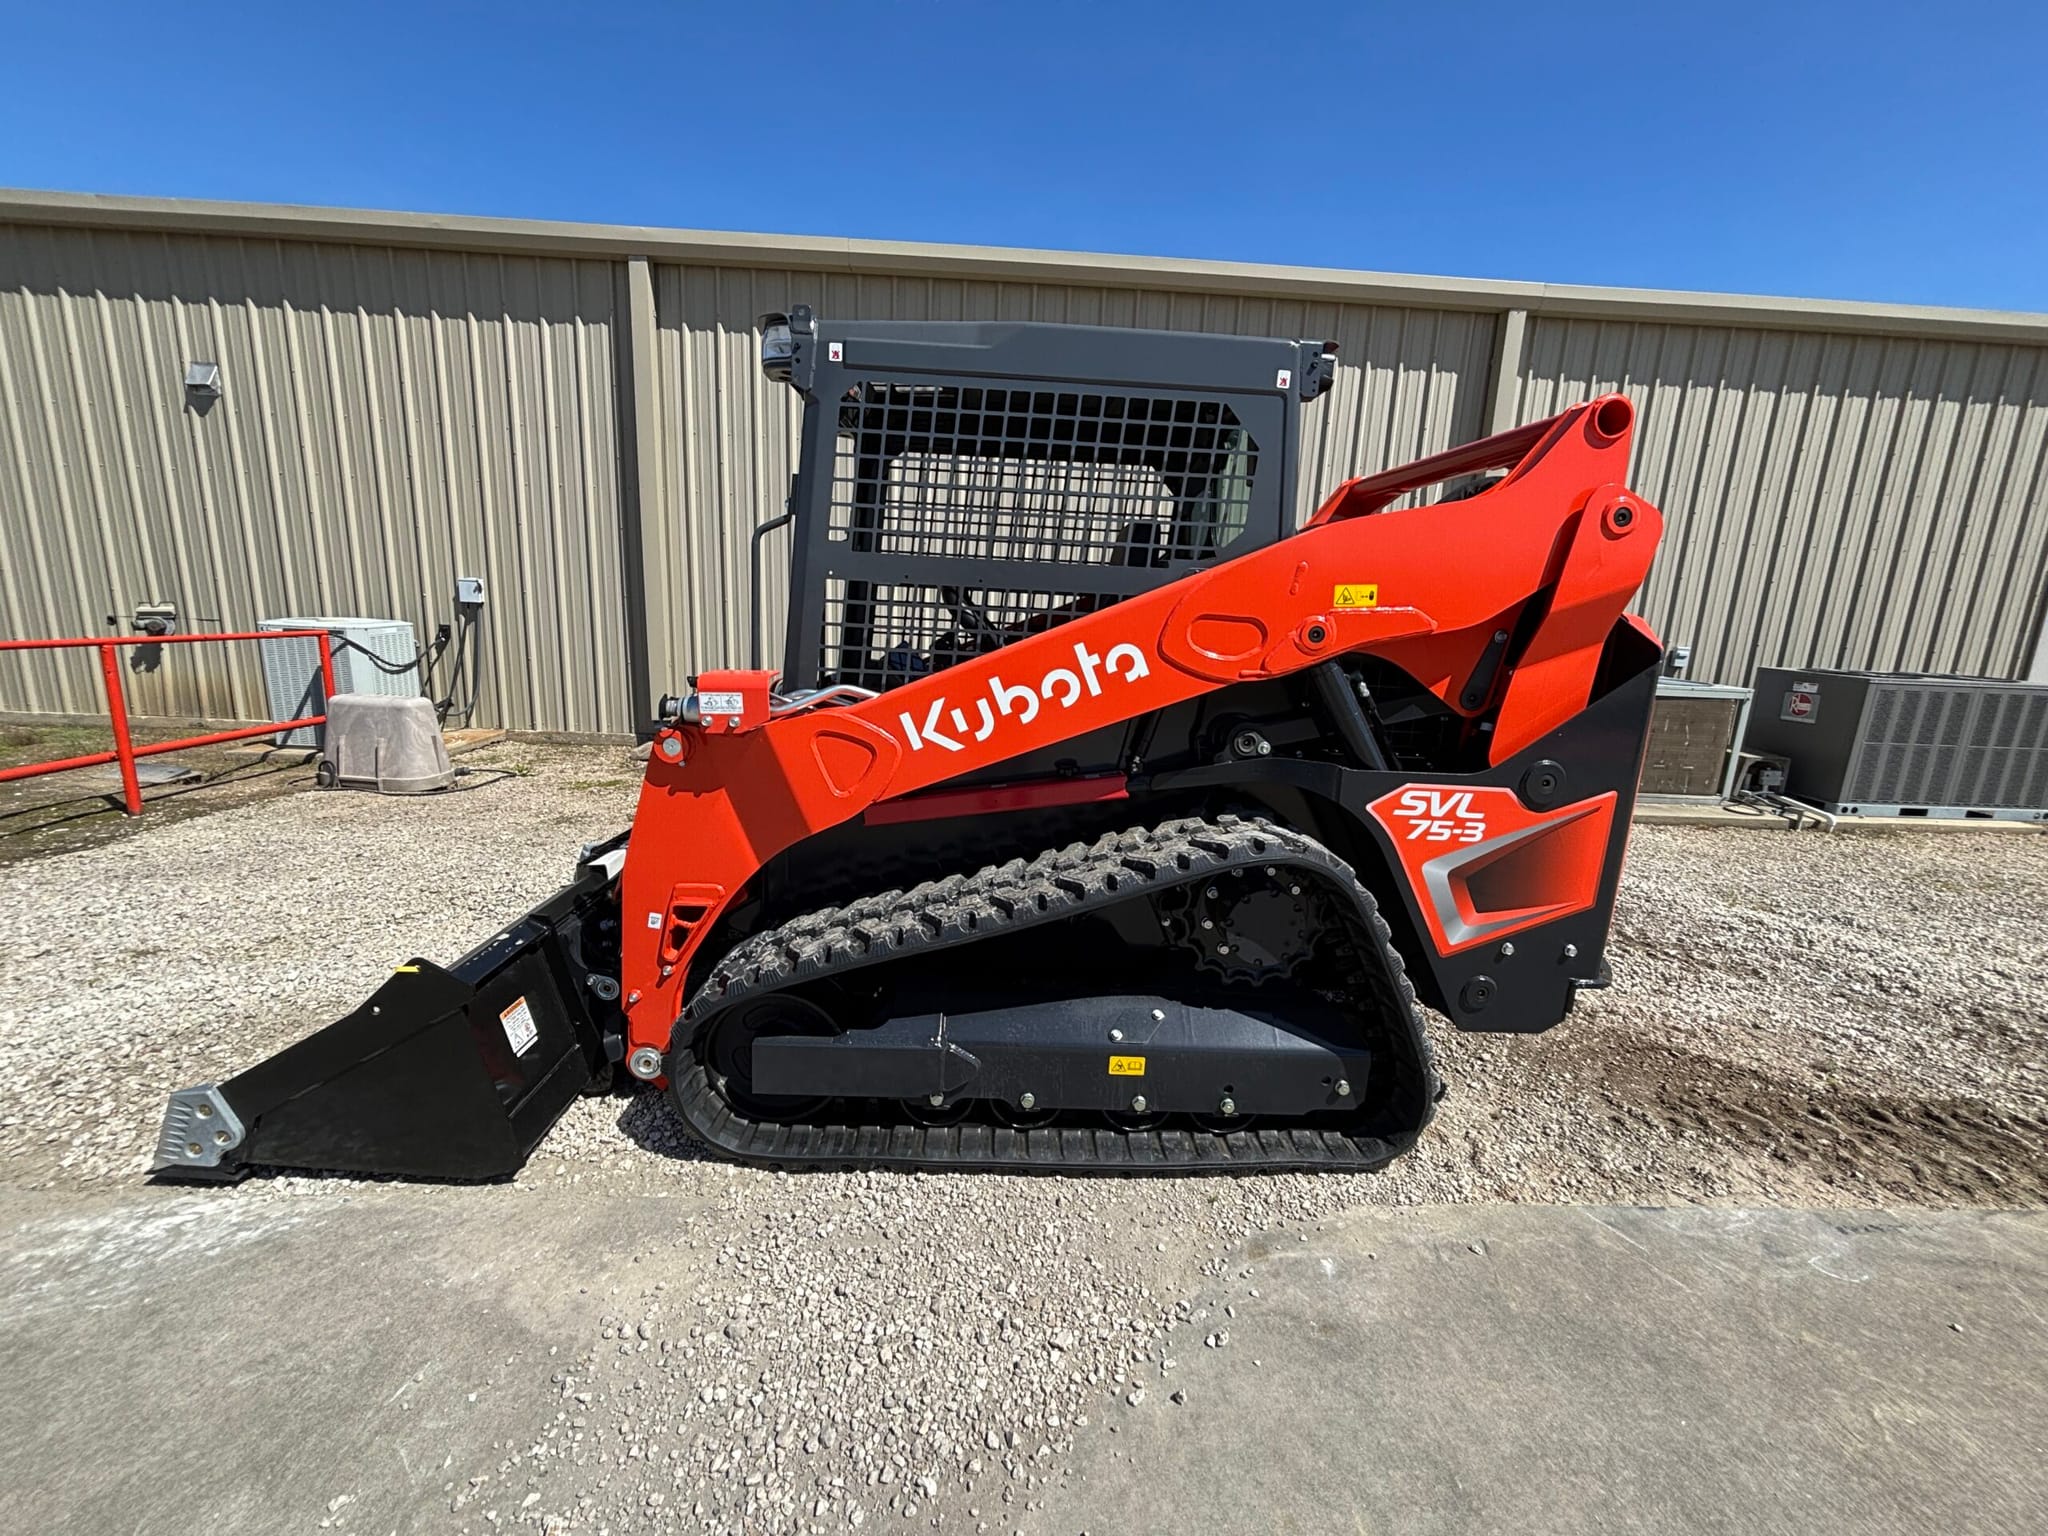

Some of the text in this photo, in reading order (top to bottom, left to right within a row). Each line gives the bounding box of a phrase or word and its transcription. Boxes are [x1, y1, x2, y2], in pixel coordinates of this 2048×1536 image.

[899, 642, 1150, 751] Kubota
[1393, 790, 1485, 819] SVL
[1406, 819, 1486, 842] 75-3
